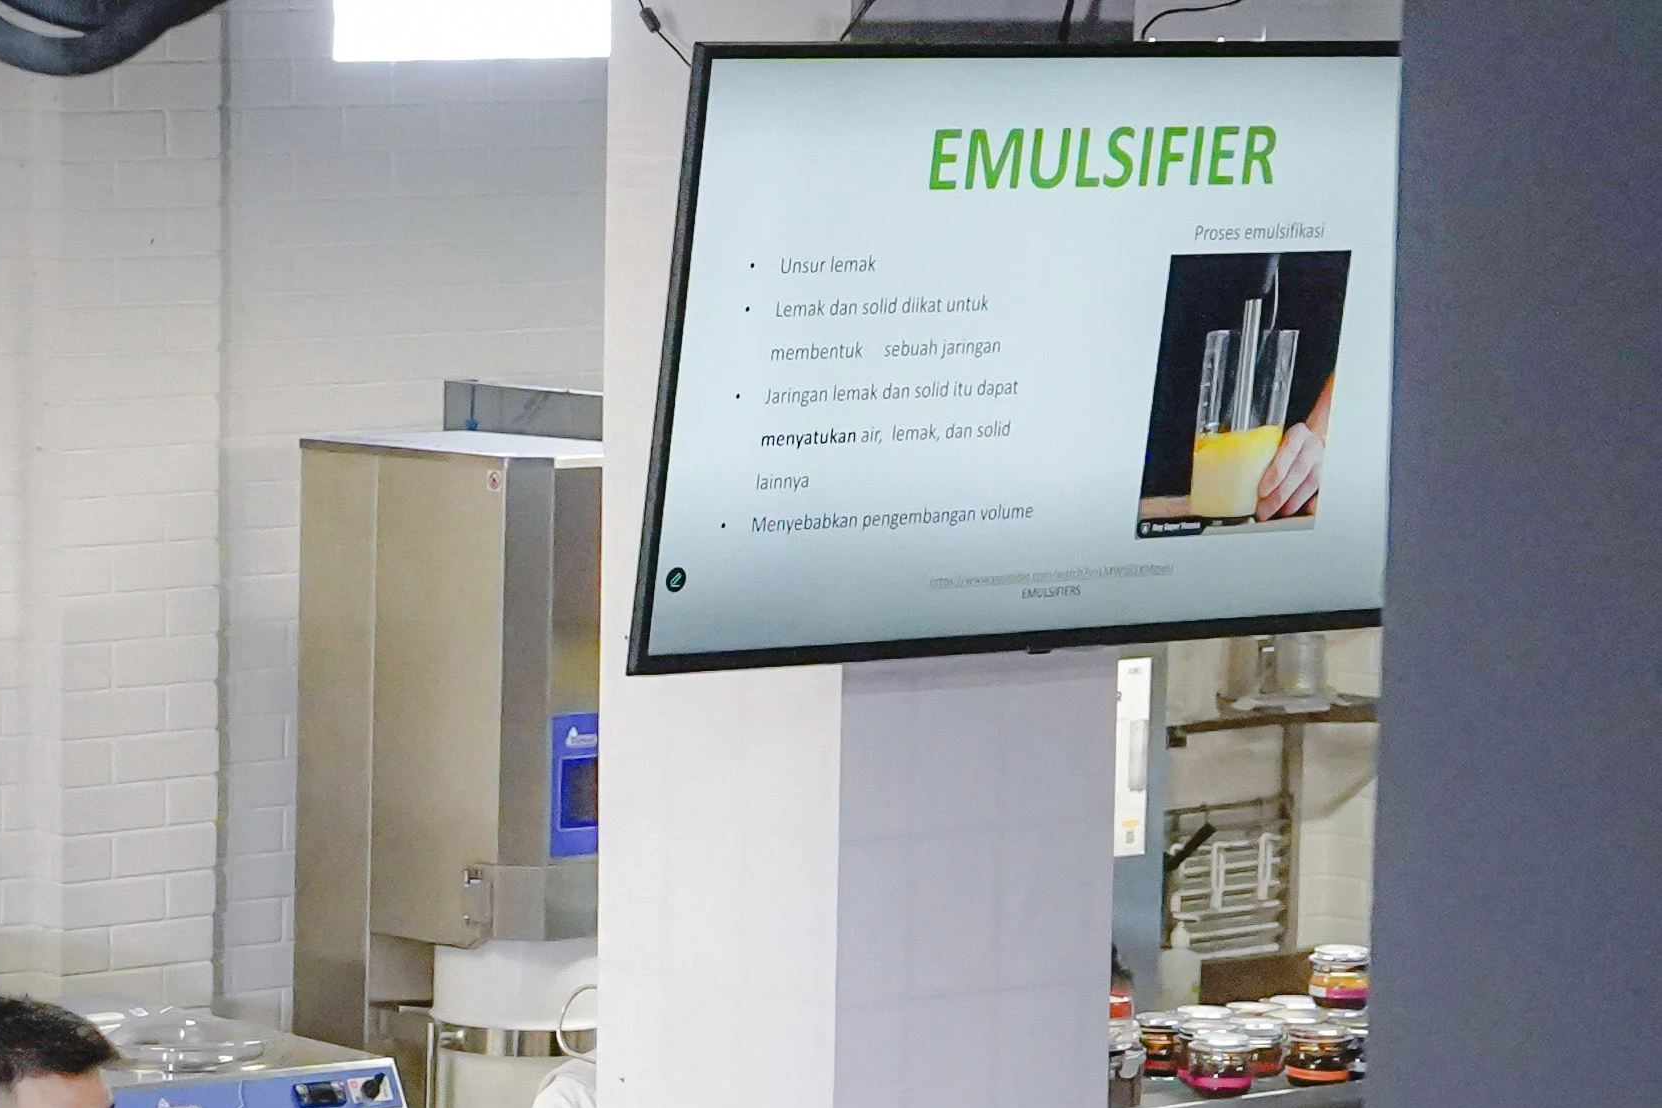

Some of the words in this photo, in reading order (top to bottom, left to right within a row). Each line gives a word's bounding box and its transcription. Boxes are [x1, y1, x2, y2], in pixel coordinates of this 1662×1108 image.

[929, 125, 1277, 190] EMULSIFIER
[1194, 224, 1241, 242] Proses
[1244, 221, 1325, 241] emulsifikasi
[780, 257, 826, 274] Unsur
[830, 254, 877, 273] lemak
[775, 299, 826, 318] Lemak
[829, 298, 858, 316] dan
[862, 296, 898, 315] solid
[901, 295, 943, 314] diikat
[946, 294, 989, 313] untuk
[770, 341, 863, 361] membentuk
[883, 339, 938, 358] sebuah
[940, 338, 1001, 359] jaringan
[764, 387, 828, 407] Jaringan
[832, 383, 878, 402] lemak
[882, 382, 910, 400] dan
[914, 381, 949, 399] solid
[953, 380, 973, 397] itu
[977, 379, 1019, 399] dapat
[761, 428, 857, 449] menyatukan
[860, 426, 883, 445] air,
[891, 422, 940, 442] lemak,
[945, 422, 973, 440] dan
[976, 420, 1011, 438] solid
[756, 473, 810, 493] lainnya
[751, 512, 858, 535] Menyebabkan
[861, 507, 976, 531] pengembangan
[980, 503, 1034, 522] volume
